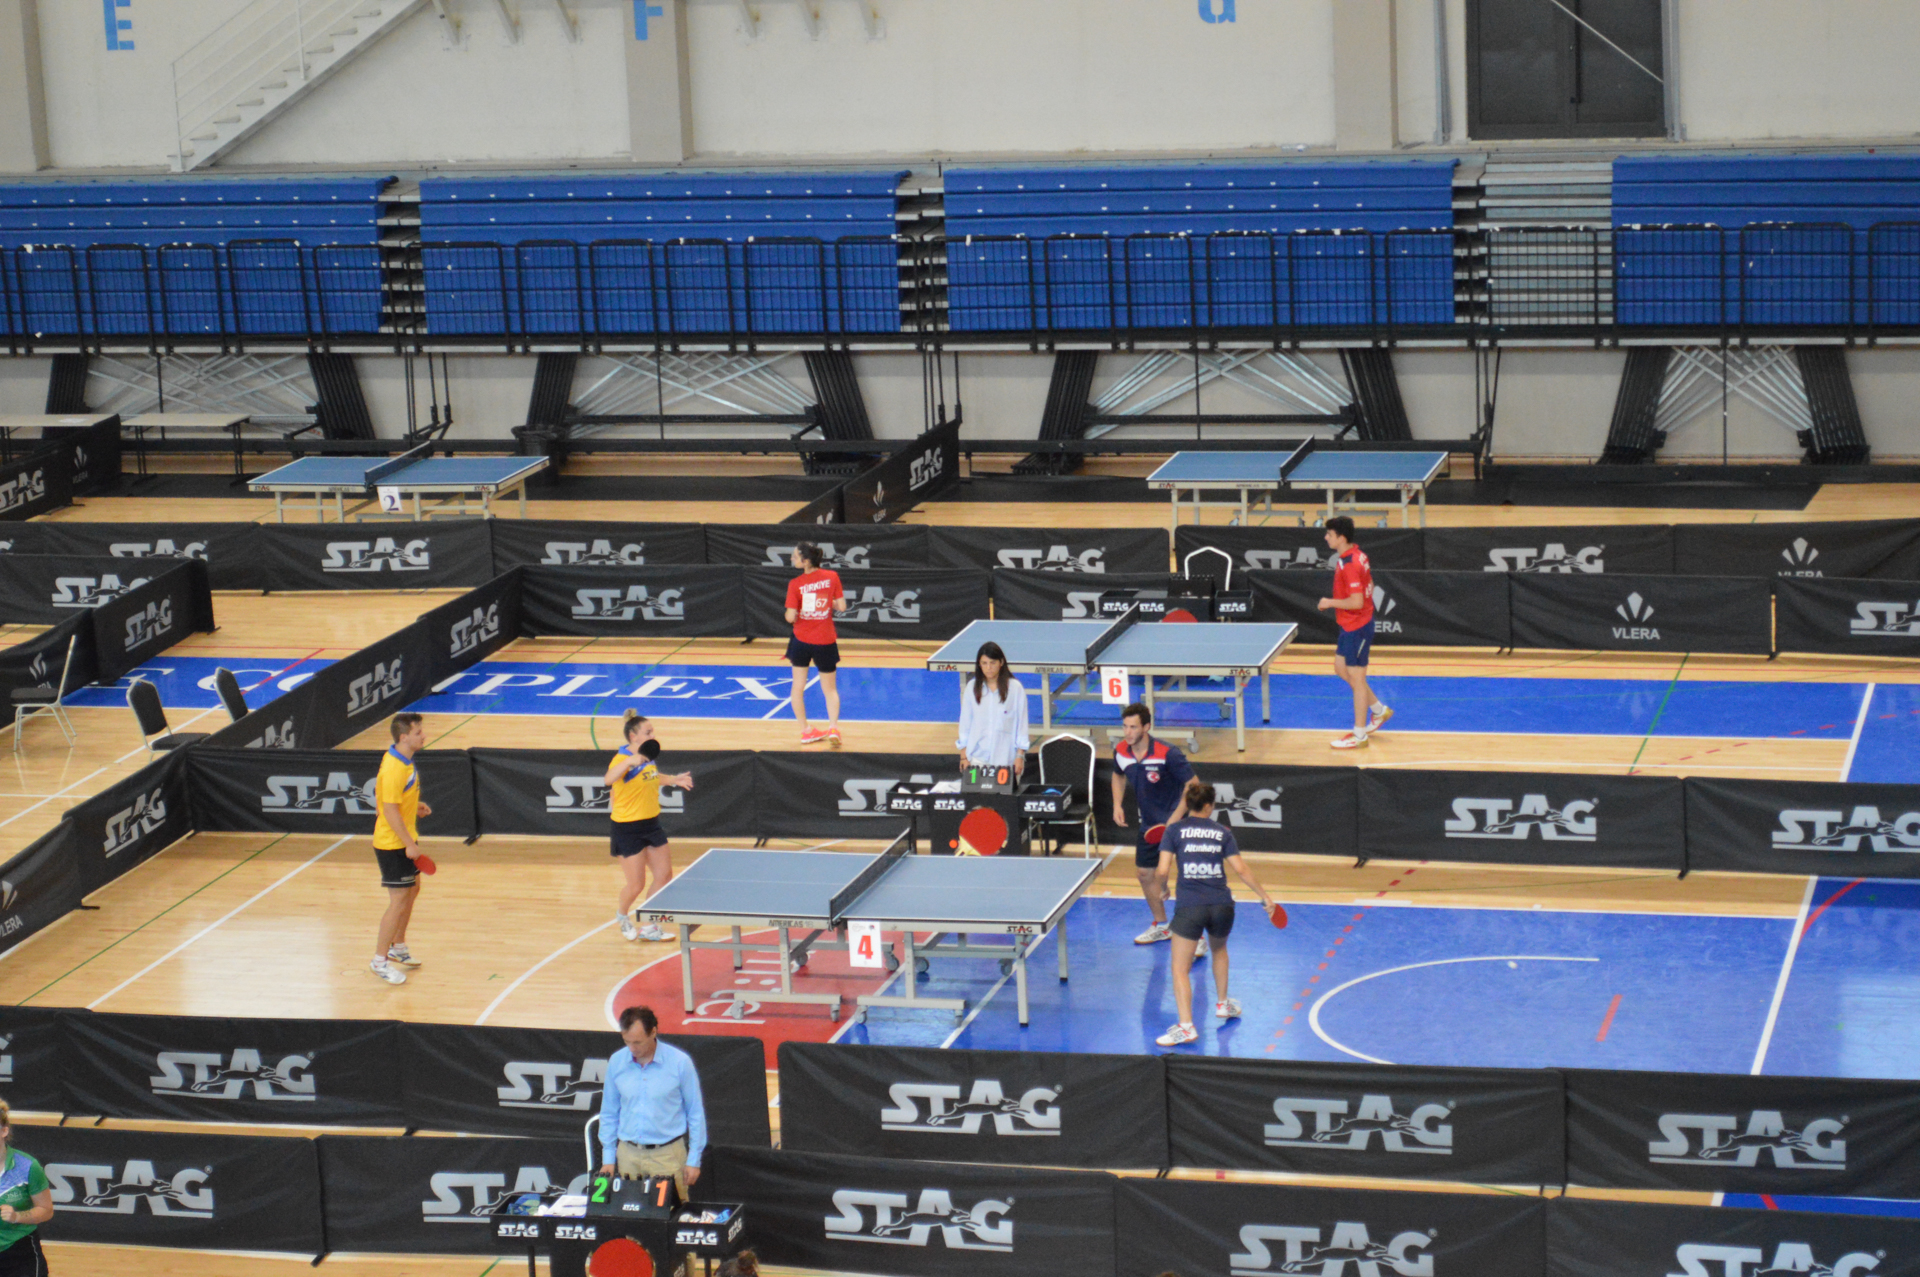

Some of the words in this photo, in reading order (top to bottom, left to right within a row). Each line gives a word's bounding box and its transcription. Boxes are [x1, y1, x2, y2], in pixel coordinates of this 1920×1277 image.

[909, 447, 942, 491] STAG
[383, 495, 399, 511] 2
[321, 538, 429, 572] STAG
[541, 539, 644, 565] STAG
[993, 545, 1105, 573] STAG
[1483, 543, 1603, 573] STAG
[572, 585, 684, 620] STAG
[1103, 602, 1128, 612] STAG
[1139, 602, 1165, 612] STAG
[1219, 601, 1246, 612] STAG
[125, 598, 172, 652] STAG
[451, 603, 499, 658] STAG
[1612, 627, 1660, 640] VLERA
[347, 658, 402, 717] STAG
[1109, 678, 1122, 698] 6
[969, 768, 976, 784] 1
[997, 768, 1008, 785] 0
[891, 799, 922, 810] STAG
[934, 799, 965, 810] STAG
[1024, 801, 1056, 812] STAG
[1445, 794, 1597, 842] STAG
[103, 788, 166, 858] STAG
[1771, 806, 1920, 853] STAG
[769, 919, 803, 928] AMERICAS
[1007, 926, 1032, 934] STAG
[858, 935, 873, 959] 4
[150, 1048, 316, 1101] STAG
[881, 1080, 1061, 1136] STAG
[1264, 1095, 1452, 1155] STAG
[1648, 1110, 1846, 1170] STAG
[45, 1160, 213, 1218] STAG
[591, 1177, 608, 1203] 2
[613, 1178, 621, 1192] 0
[643, 1180, 650, 1193] 1
[656, 1180, 668, 1207] 1
[622, 1203, 640, 1211] STAG
[824, 1189, 1013, 1253] STAG
[498, 1223, 539, 1238] STAG
[555, 1225, 596, 1240] STAG
[675, 1231, 717, 1245] STAG
[1230, 1222, 1434, 1277] STAG
